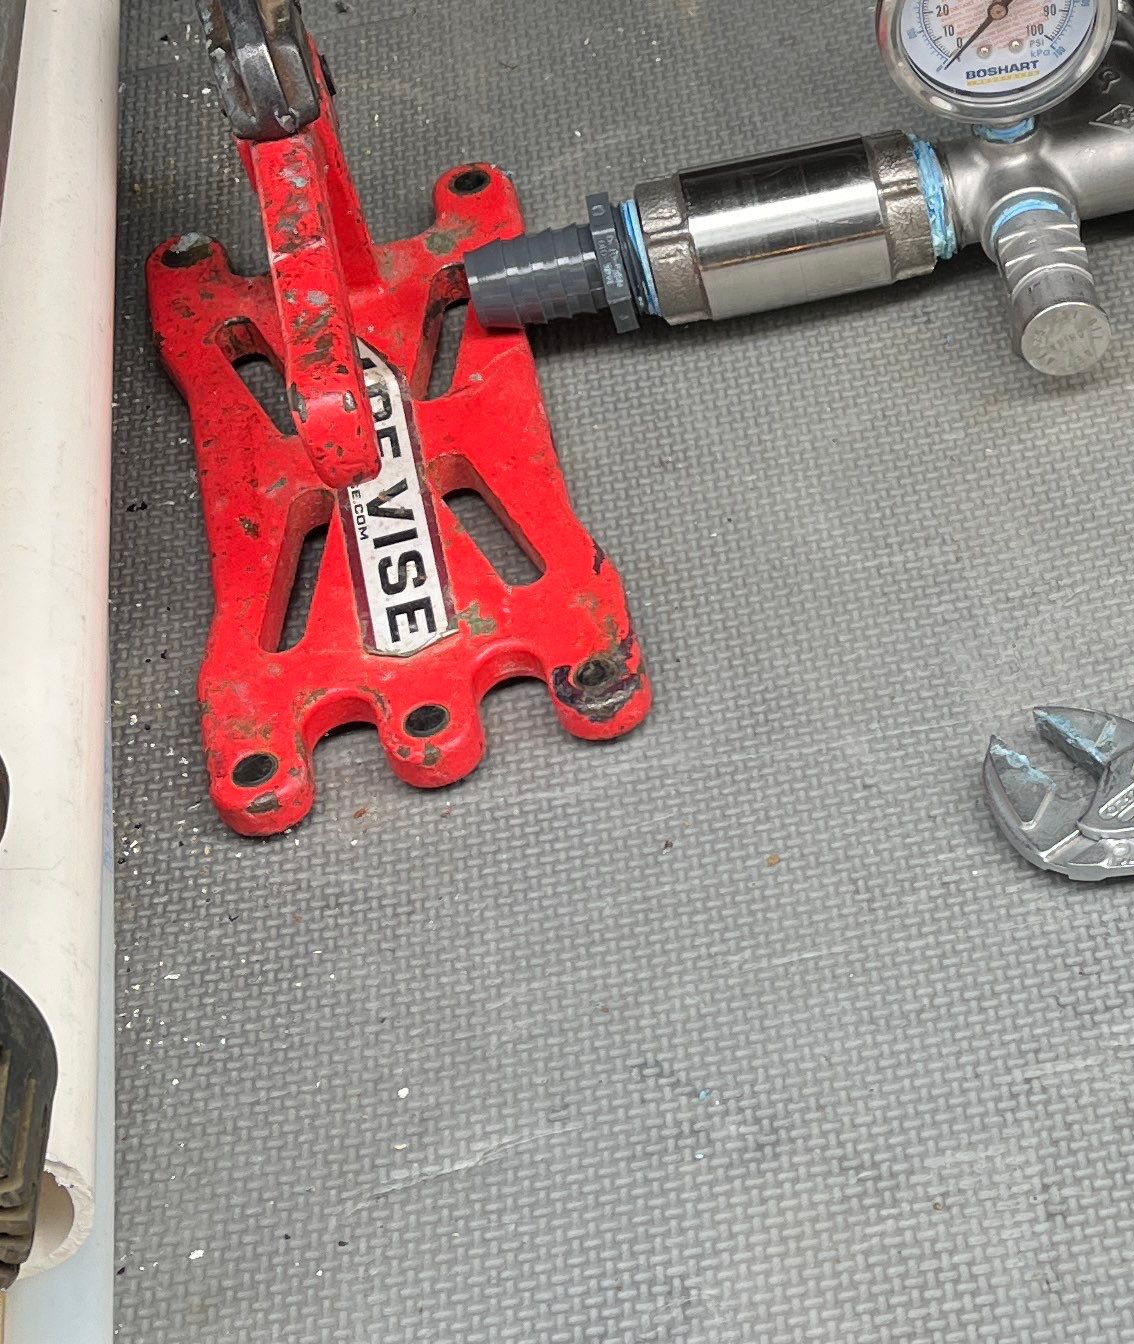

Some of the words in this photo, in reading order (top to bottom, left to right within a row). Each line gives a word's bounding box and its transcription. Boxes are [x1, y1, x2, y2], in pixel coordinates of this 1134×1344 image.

[935, 3, 950, 17] 20
[1043, 3, 1057, 17] 90
[943, 24, 955, 37] 10
[1025, 23, 1044, 37] 100
[956, 36, 963, 49] 0
[1029, 38, 1045, 48] PSI
[965, 59, 1040, 80] BOSHART
[365, 477, 437, 644] VISE
